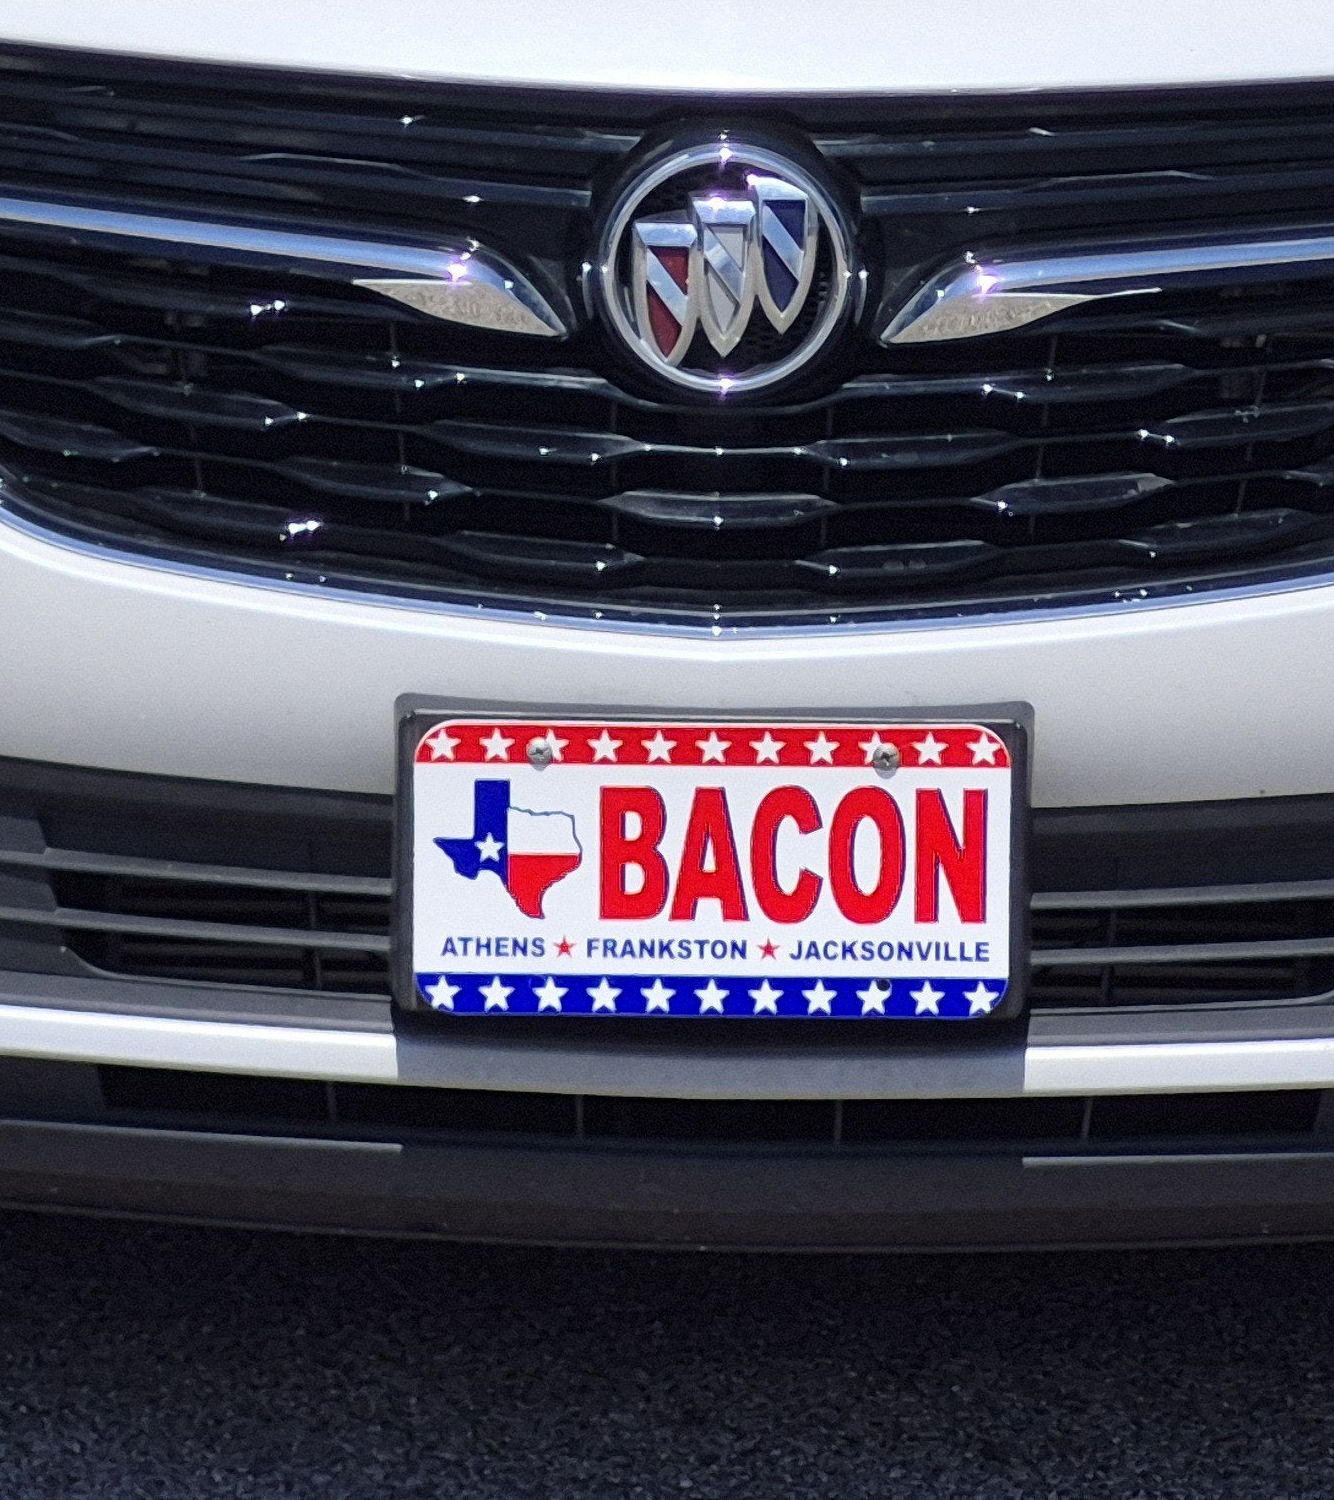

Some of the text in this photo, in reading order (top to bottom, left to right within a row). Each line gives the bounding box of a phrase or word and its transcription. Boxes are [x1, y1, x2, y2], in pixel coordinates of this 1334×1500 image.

[598, 784, 990, 924] BACON
[441, 936, 991, 963] ATHENS FRANKSTON JACKSONVILLE
